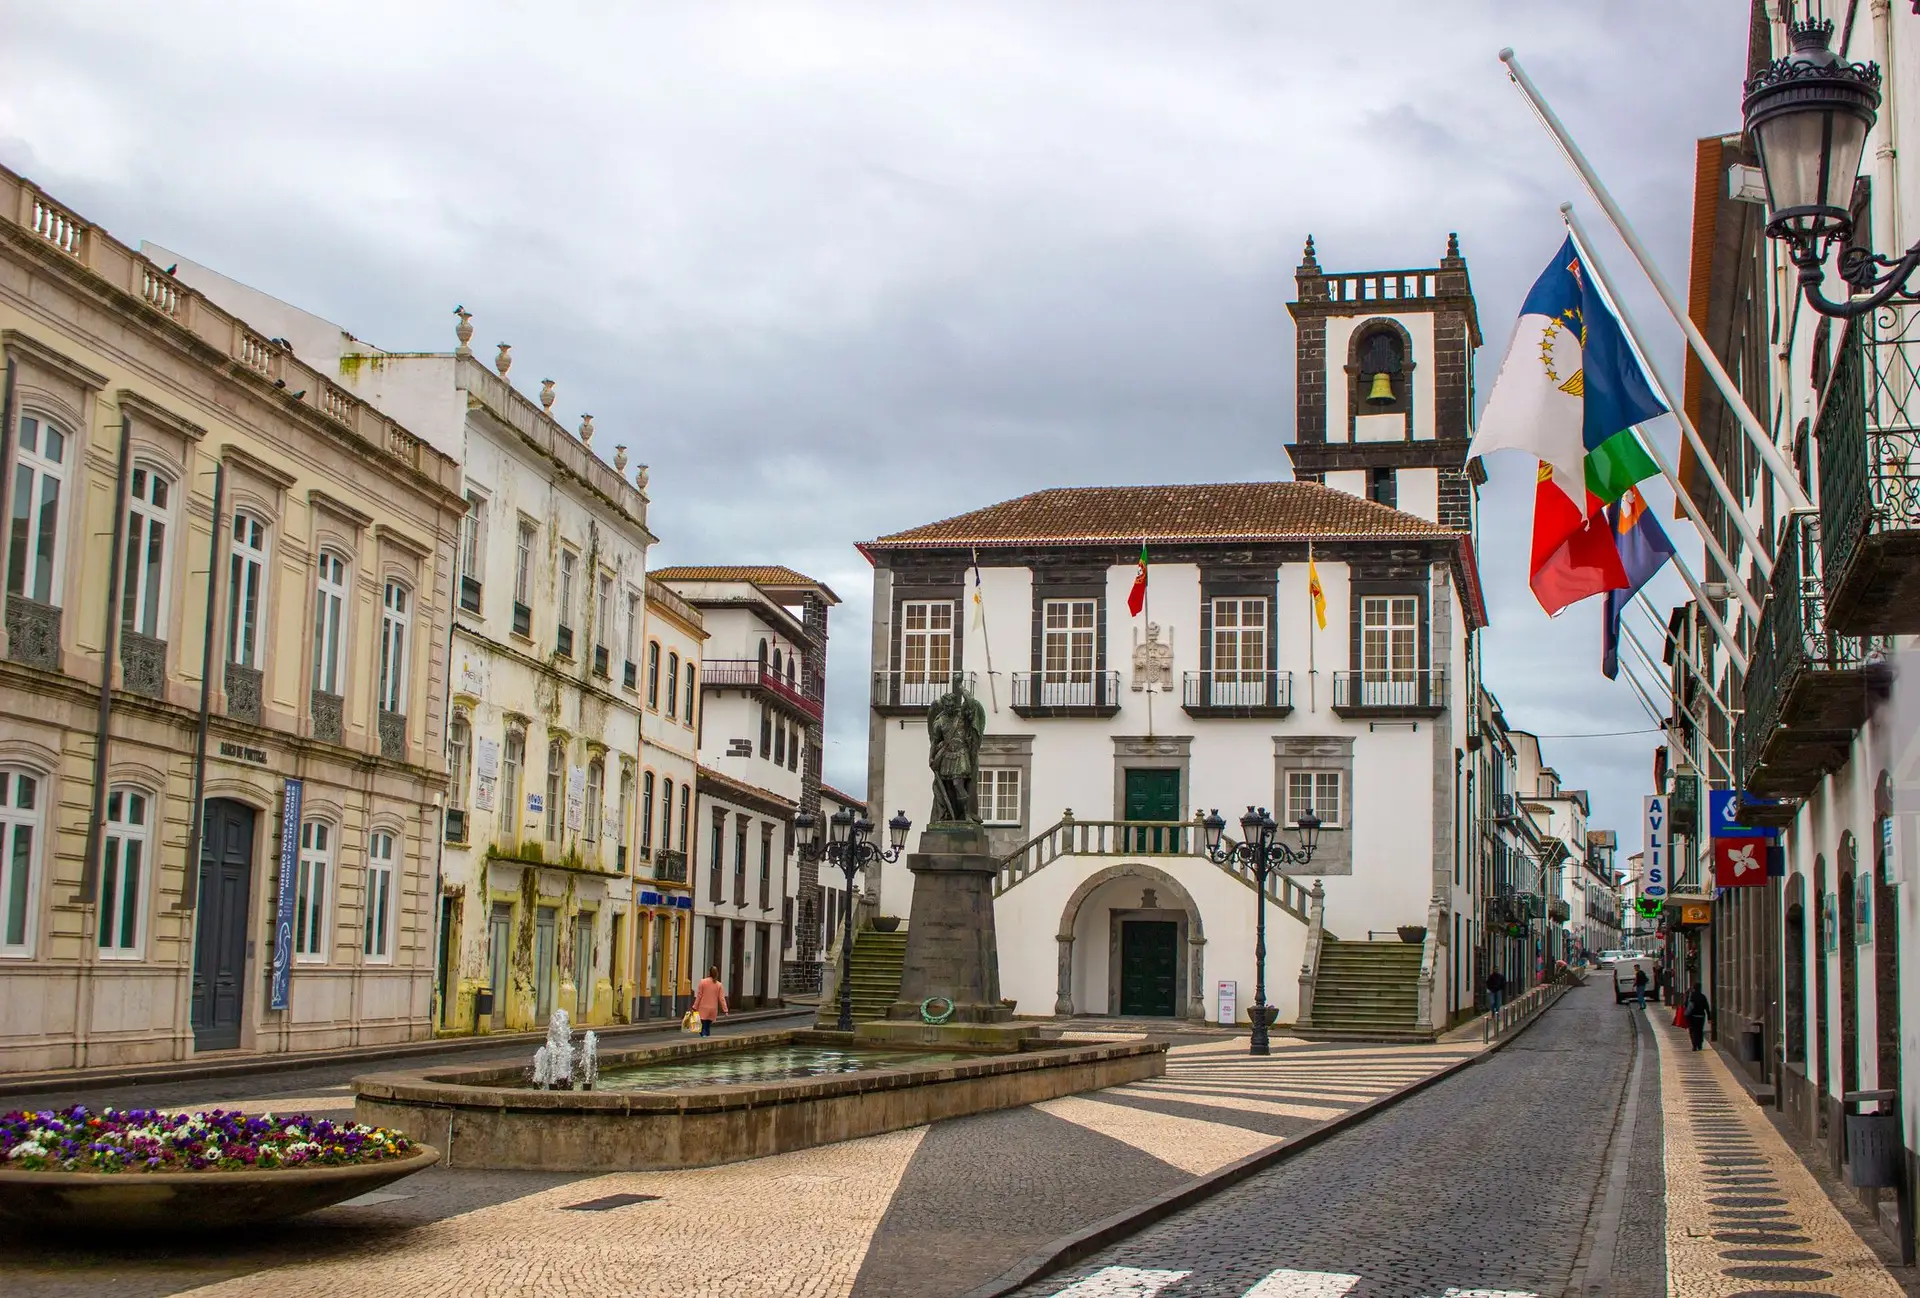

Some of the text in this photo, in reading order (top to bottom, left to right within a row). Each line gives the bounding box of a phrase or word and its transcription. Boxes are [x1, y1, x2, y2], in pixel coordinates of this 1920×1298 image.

[287, 841, 293, 852] IN
[1649, 799, 1662, 882] AVLIS
[279, 854, 287, 906] DINHEIRO
[278, 909, 284, 917] O
